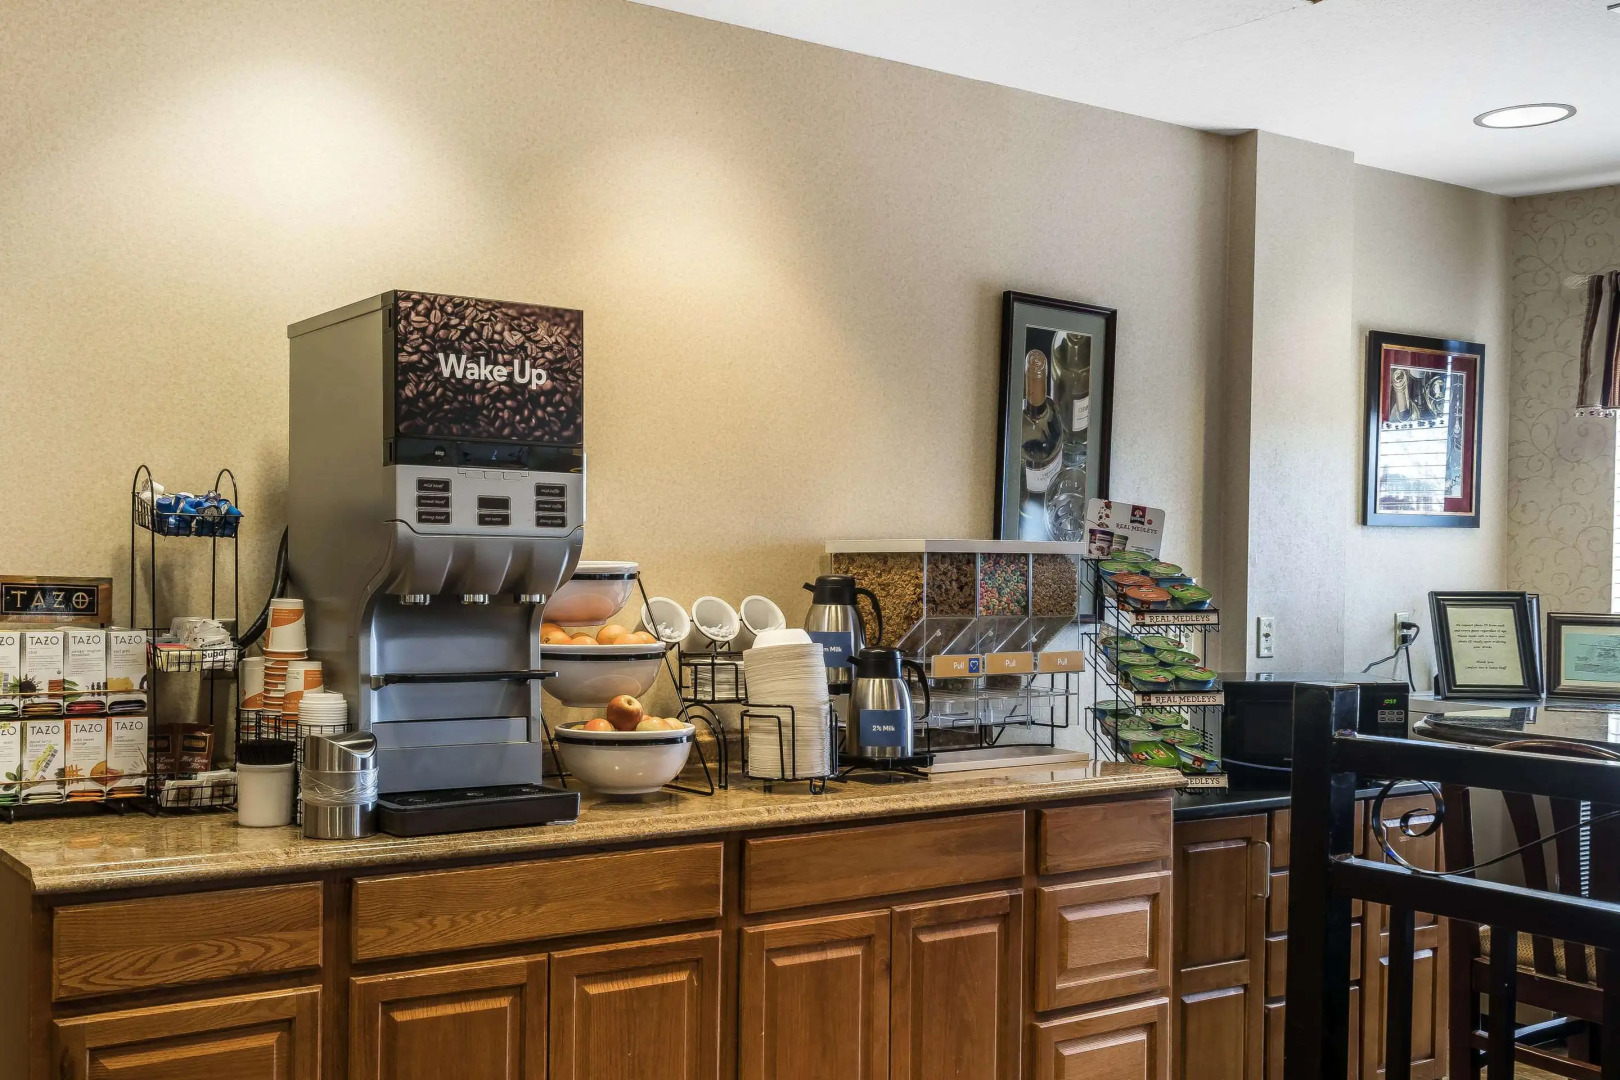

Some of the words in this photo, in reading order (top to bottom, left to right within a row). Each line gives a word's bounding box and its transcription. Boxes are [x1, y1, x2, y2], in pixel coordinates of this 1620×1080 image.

[438, 353, 507, 383] Wake
[513, 358, 547, 389] Up
[1131, 526, 1158, 534] MEDLEYS
[11, 590, 89, 609] TAZO
[1149, 615, 1171, 624] REAL
[1171, 614, 1210, 623] MEDLEYS
[29, 636, 59, 646] TAZO
[71, 635, 101, 645] TAZO
[114, 635, 143, 645] TAZO
[953, 661, 964, 670] Pull
[1005, 659, 1016, 667] Pull
[1057, 658, 1068, 666] Pull
[1155, 696, 1177, 705] REAL
[1178, 695, 1217, 704] MEDLEYS
[30, 725, 60, 735] TAZO
[73, 724, 103, 733] TAZO
[115, 721, 144, 731] TAZO
[872, 724, 882, 732] 2%
[1187, 777, 1220, 785] EDLEYS
